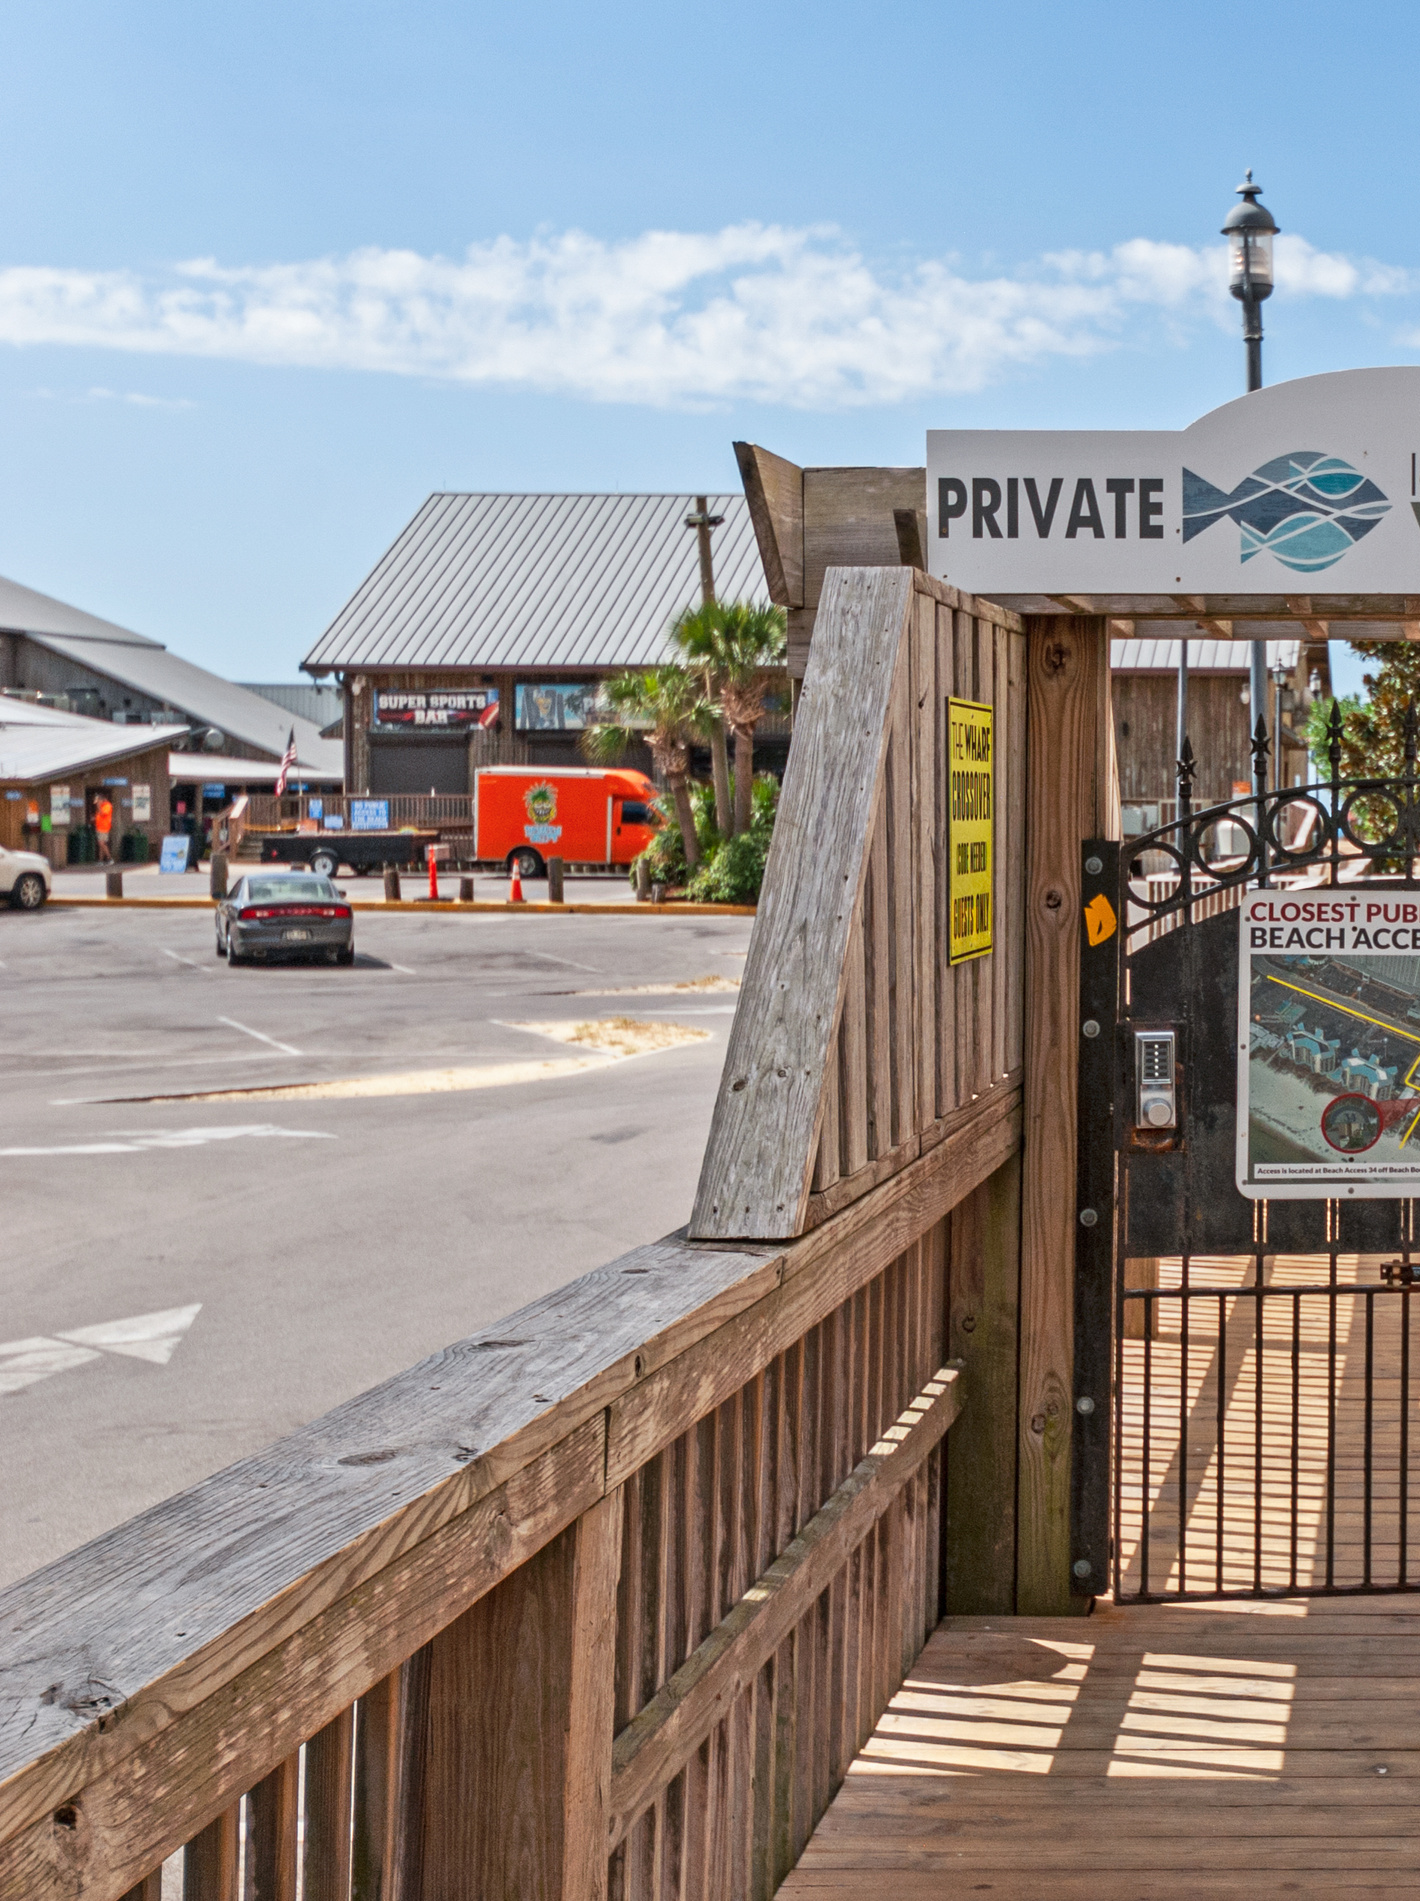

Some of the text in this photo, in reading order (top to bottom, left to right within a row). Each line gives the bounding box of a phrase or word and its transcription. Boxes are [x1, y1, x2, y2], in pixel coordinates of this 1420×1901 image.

[938, 477, 1164, 539] PRIVATE
[379, 694, 487, 710] SUPER SPORTS
[414, 709, 448, 724] BAR
[952, 722, 990, 763] THE WHARF
[953, 770, 990, 821] CROSSOVER
[1250, 902, 1360, 922] CLOSEST
[1250, 927, 1345, 949] BEACH
